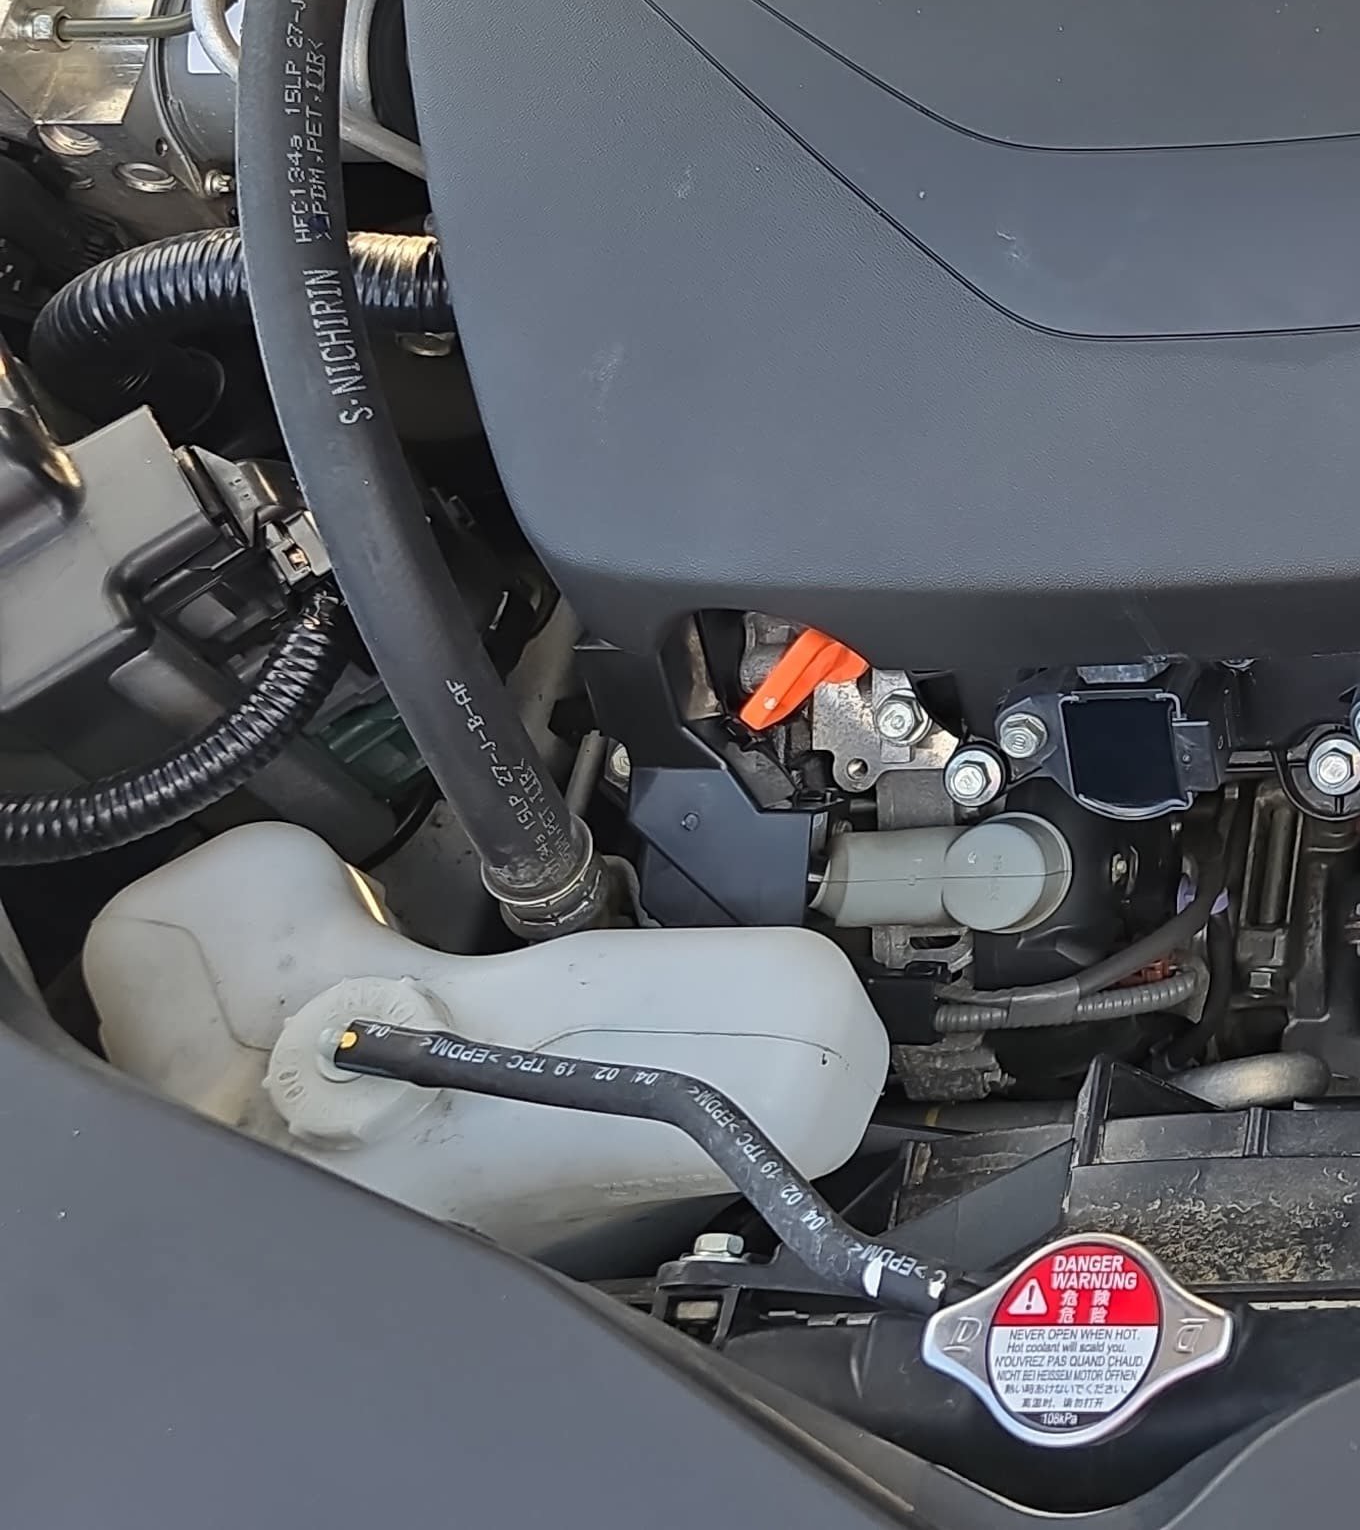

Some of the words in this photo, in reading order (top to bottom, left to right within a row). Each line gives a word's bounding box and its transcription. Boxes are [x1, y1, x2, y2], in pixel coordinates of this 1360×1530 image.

[506, 1054, 546, 1073] TPC
[735, 1132, 766, 1163] TPC
[1053, 1255, 1124, 1272] DANGER
[1051, 1272, 1138, 1290] WARNUNG
[1009, 1329, 1044, 1340] NEVER
[1047, 1329, 1077, 1340] OPEN
[1080, 1329, 1112, 1340] WHEN
[1115, 1329, 1141, 1341] HOT.
[1006, 1342, 1023, 1353] Hot
[1026, 1342, 1060, 1353] coolant
[1062, 1342, 1077, 1353] will
[1079, 1342, 1105, 1353] scald
[1107, 1345, 1127, 1355] you.
[995, 1356, 1043, 1367] N'OUVREZ
[1046, 1356, 1066, 1367] PAS
[1069, 1356, 1105, 1367] QUAND
[997, 1370, 1021, 1381] NICHT
[1073, 1370, 1103, 1381] MOTOR
